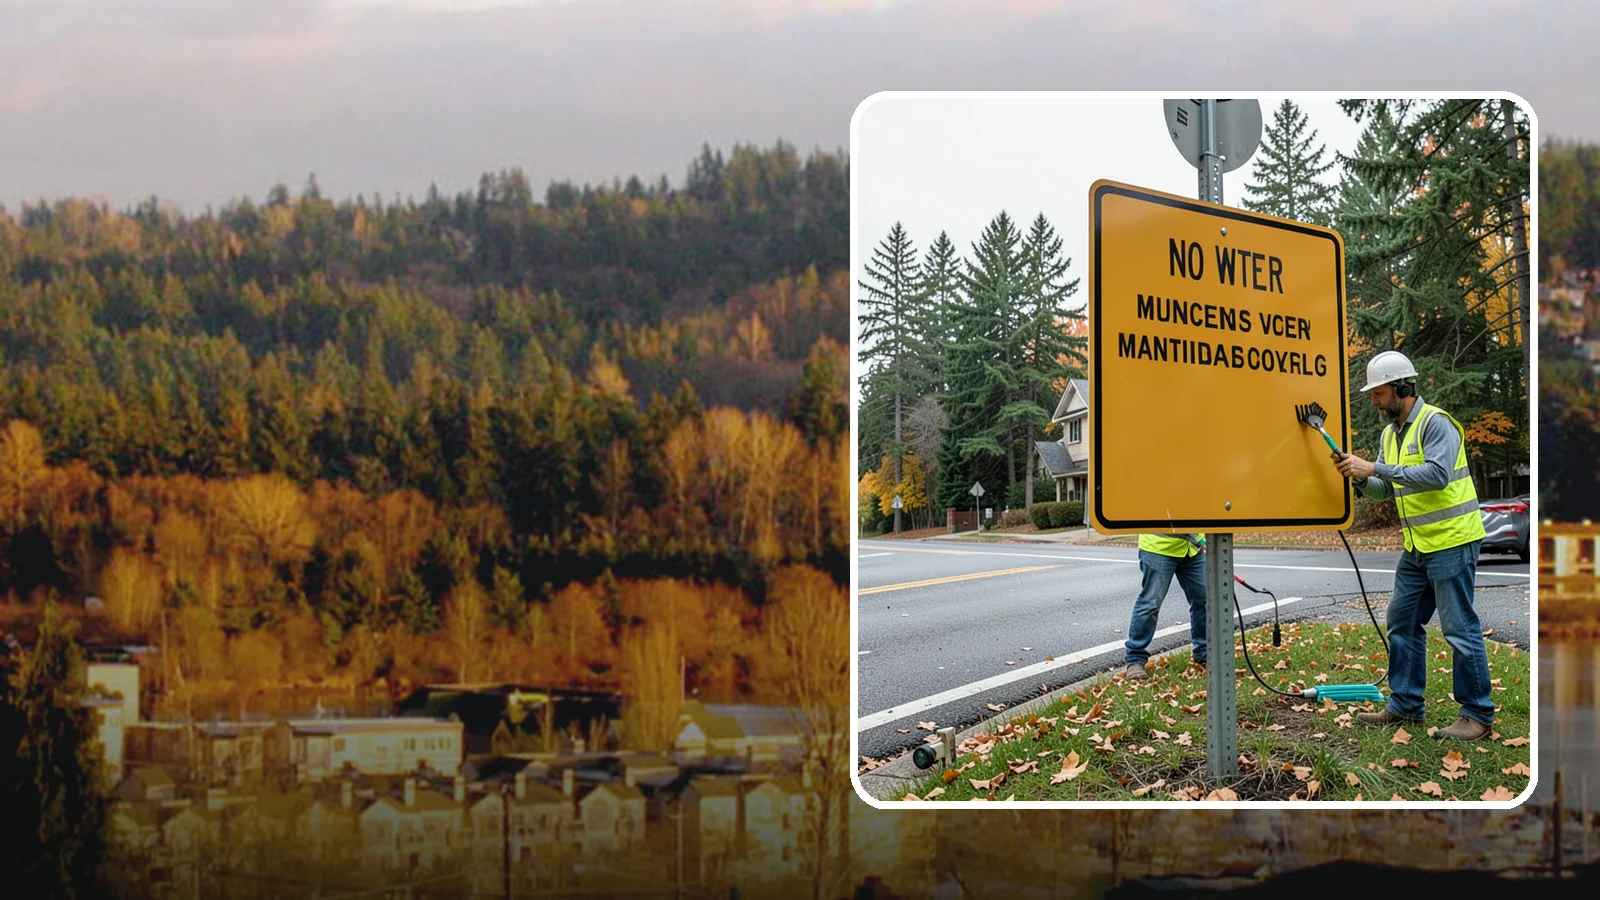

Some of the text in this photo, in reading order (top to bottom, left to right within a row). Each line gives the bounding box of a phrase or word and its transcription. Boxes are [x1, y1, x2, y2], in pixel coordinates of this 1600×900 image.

[1169, 238, 1284, 294] NO WTER
[1137, 294, 1252, 332] MUNCENS
